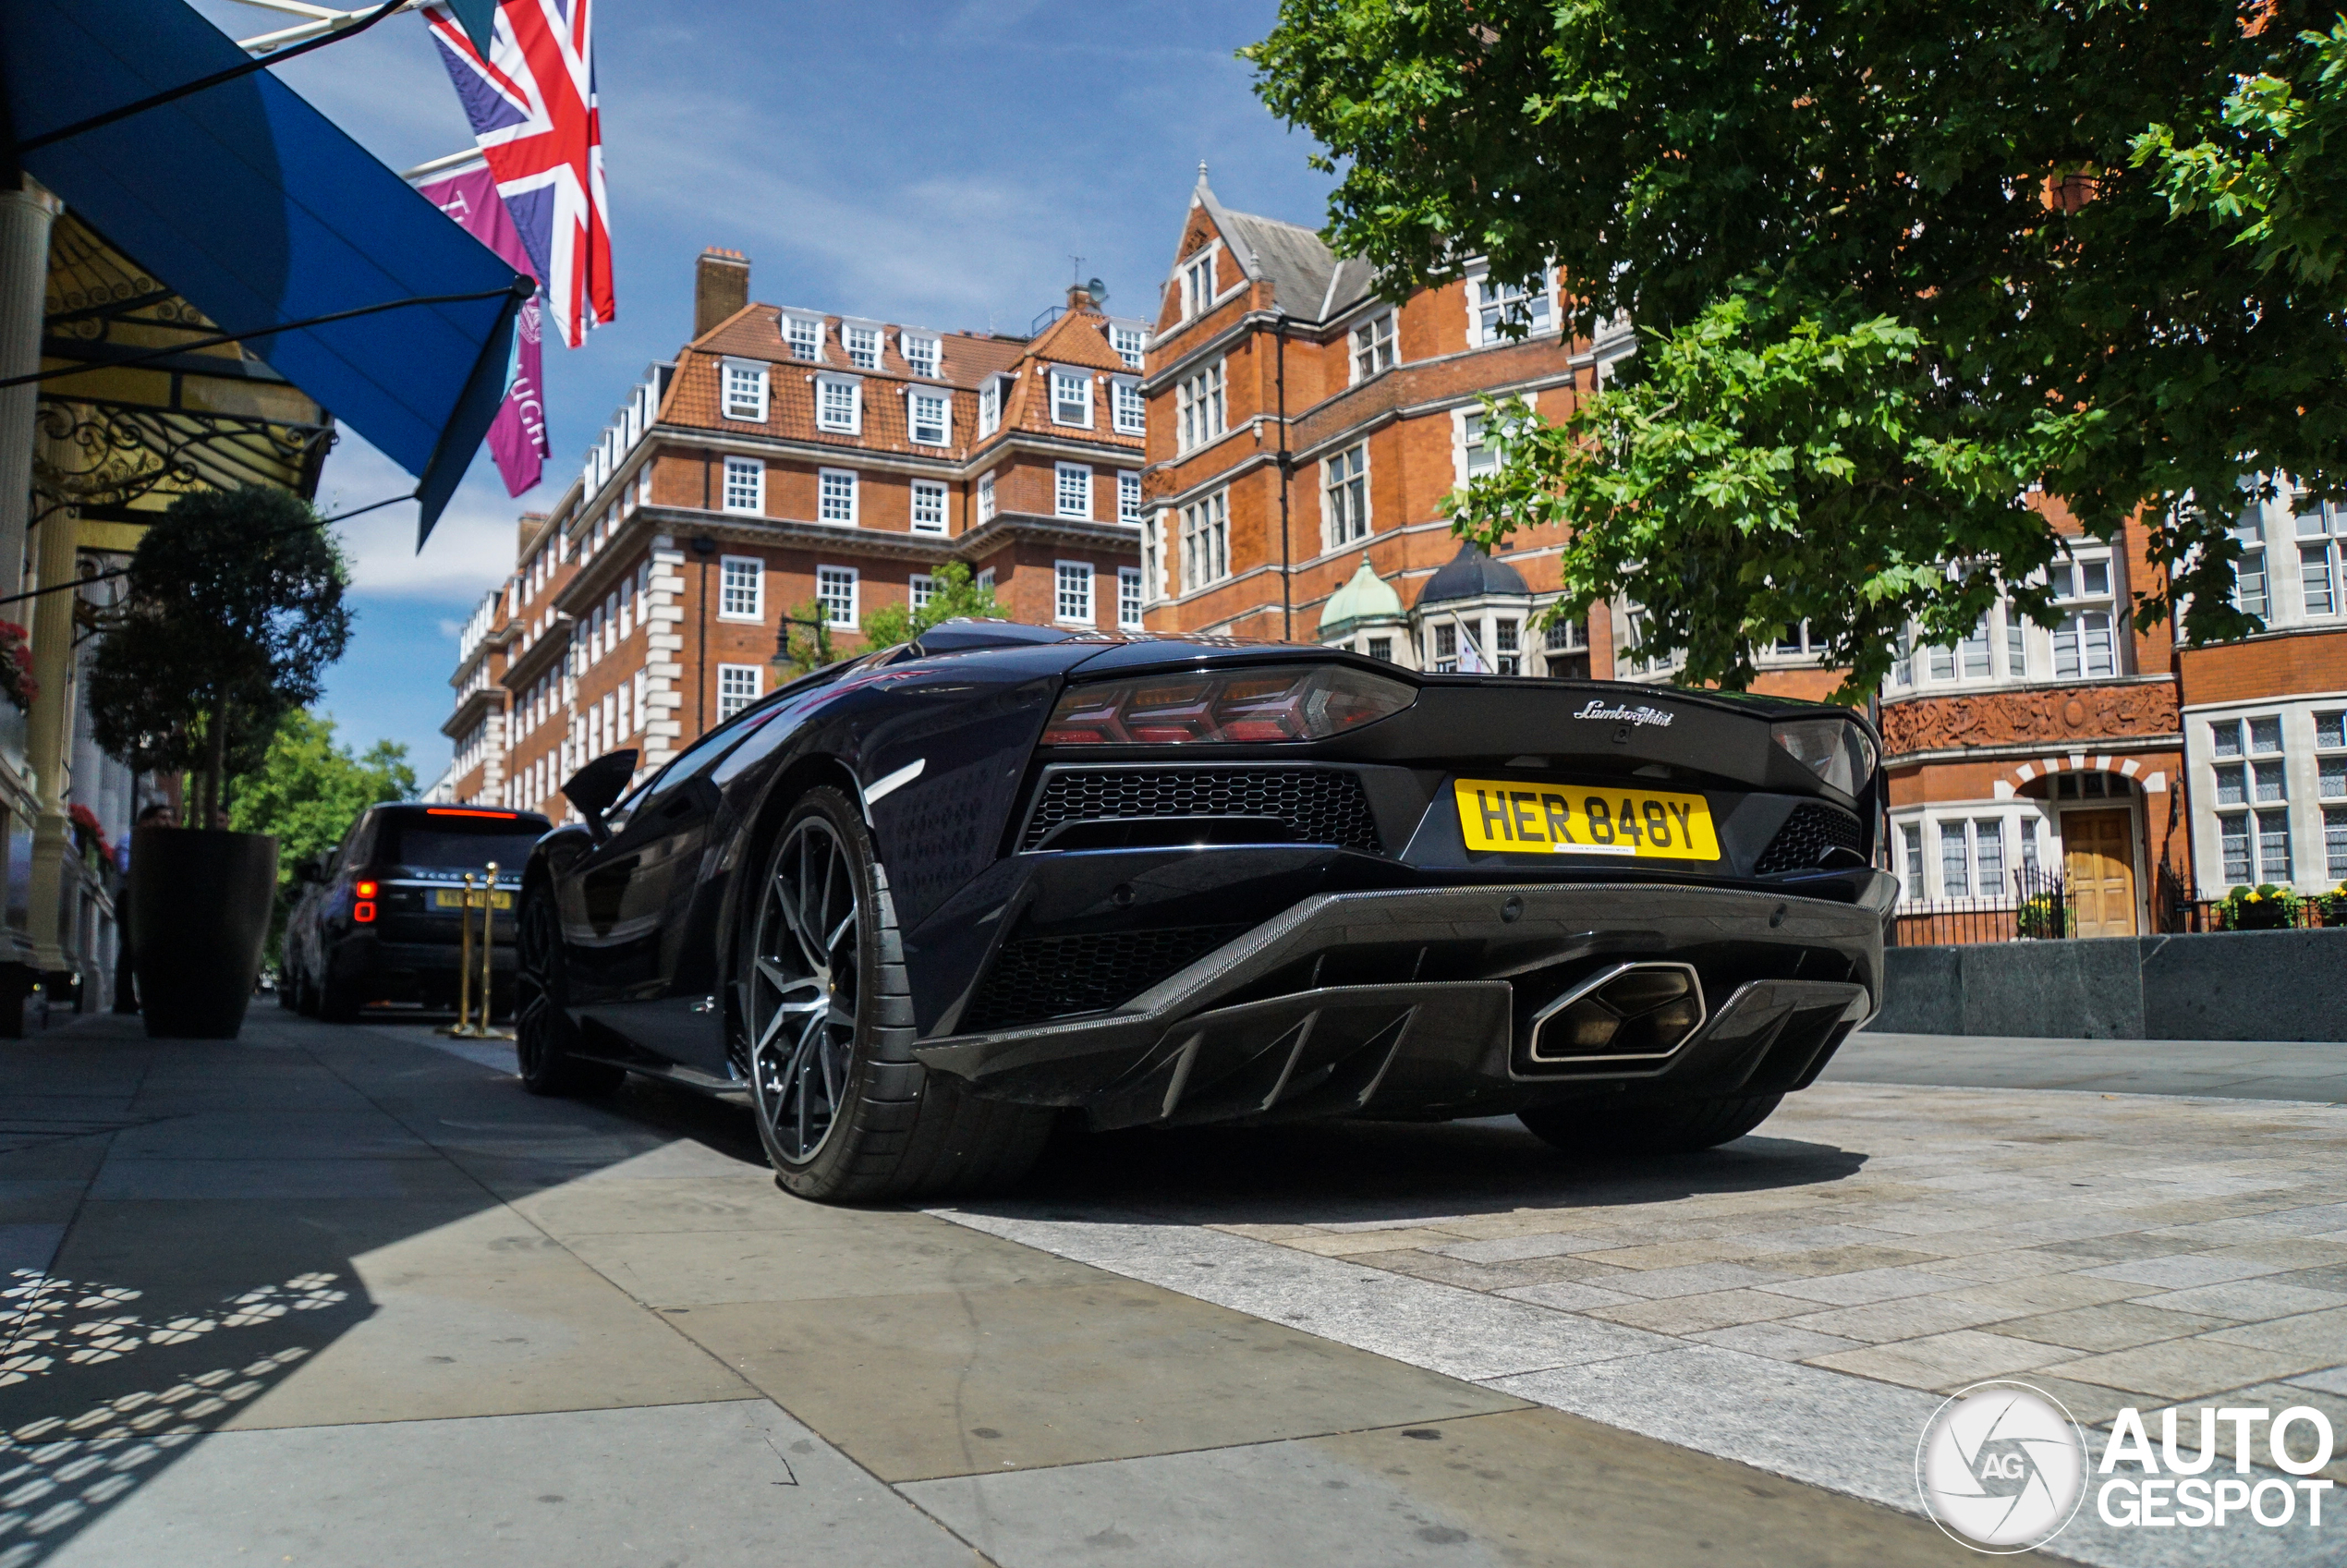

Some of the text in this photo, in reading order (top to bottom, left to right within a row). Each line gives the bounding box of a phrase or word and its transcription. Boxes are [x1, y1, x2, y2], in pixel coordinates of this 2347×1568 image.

[1573, 699, 1674, 727] Lamborghini
[1477, 789, 1693, 849] HER 848Y
